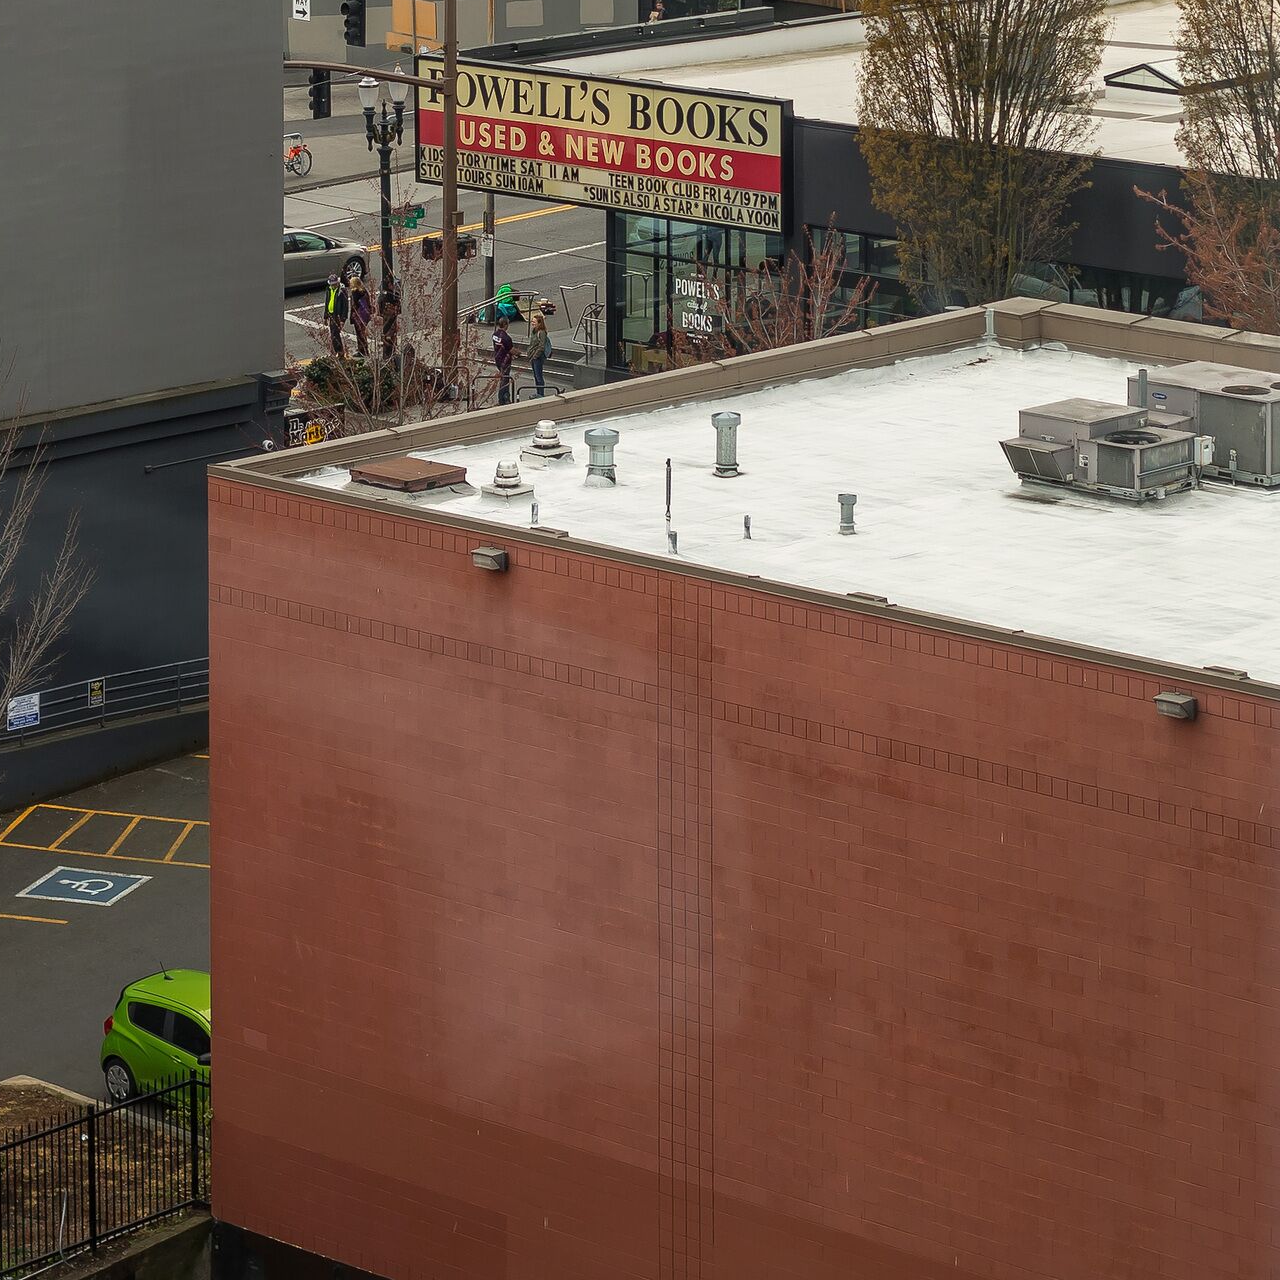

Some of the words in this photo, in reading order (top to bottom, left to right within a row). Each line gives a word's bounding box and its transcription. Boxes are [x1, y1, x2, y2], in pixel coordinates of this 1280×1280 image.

[627, 92, 768, 147] BOOKS
[420, 146, 445, 163] KIDS
[521, 161, 543, 177] SAT
[549, 165, 557, 179] 11
[562, 167, 580, 182] AM
[459, 120, 527, 151] USED
[538, 131, 556, 156] &
[565, 134, 625, 165] NEW
[636, 143, 734, 181] BOOKS
[459, 169, 492, 186] TOURS
[495, 173, 516, 190] SUN
[608, 173, 634, 190] TEEN
[638, 177, 669, 195] BOOK
[672, 182, 700, 200] CLUB
[703, 186, 721, 203] FRI
[623, 191, 650, 209] ALSO
[653, 196, 664, 211] A
[703, 202, 743, 223] NICOLA
[747, 208, 779, 228] YOON
[682, 312, 713, 333] BOOKS
